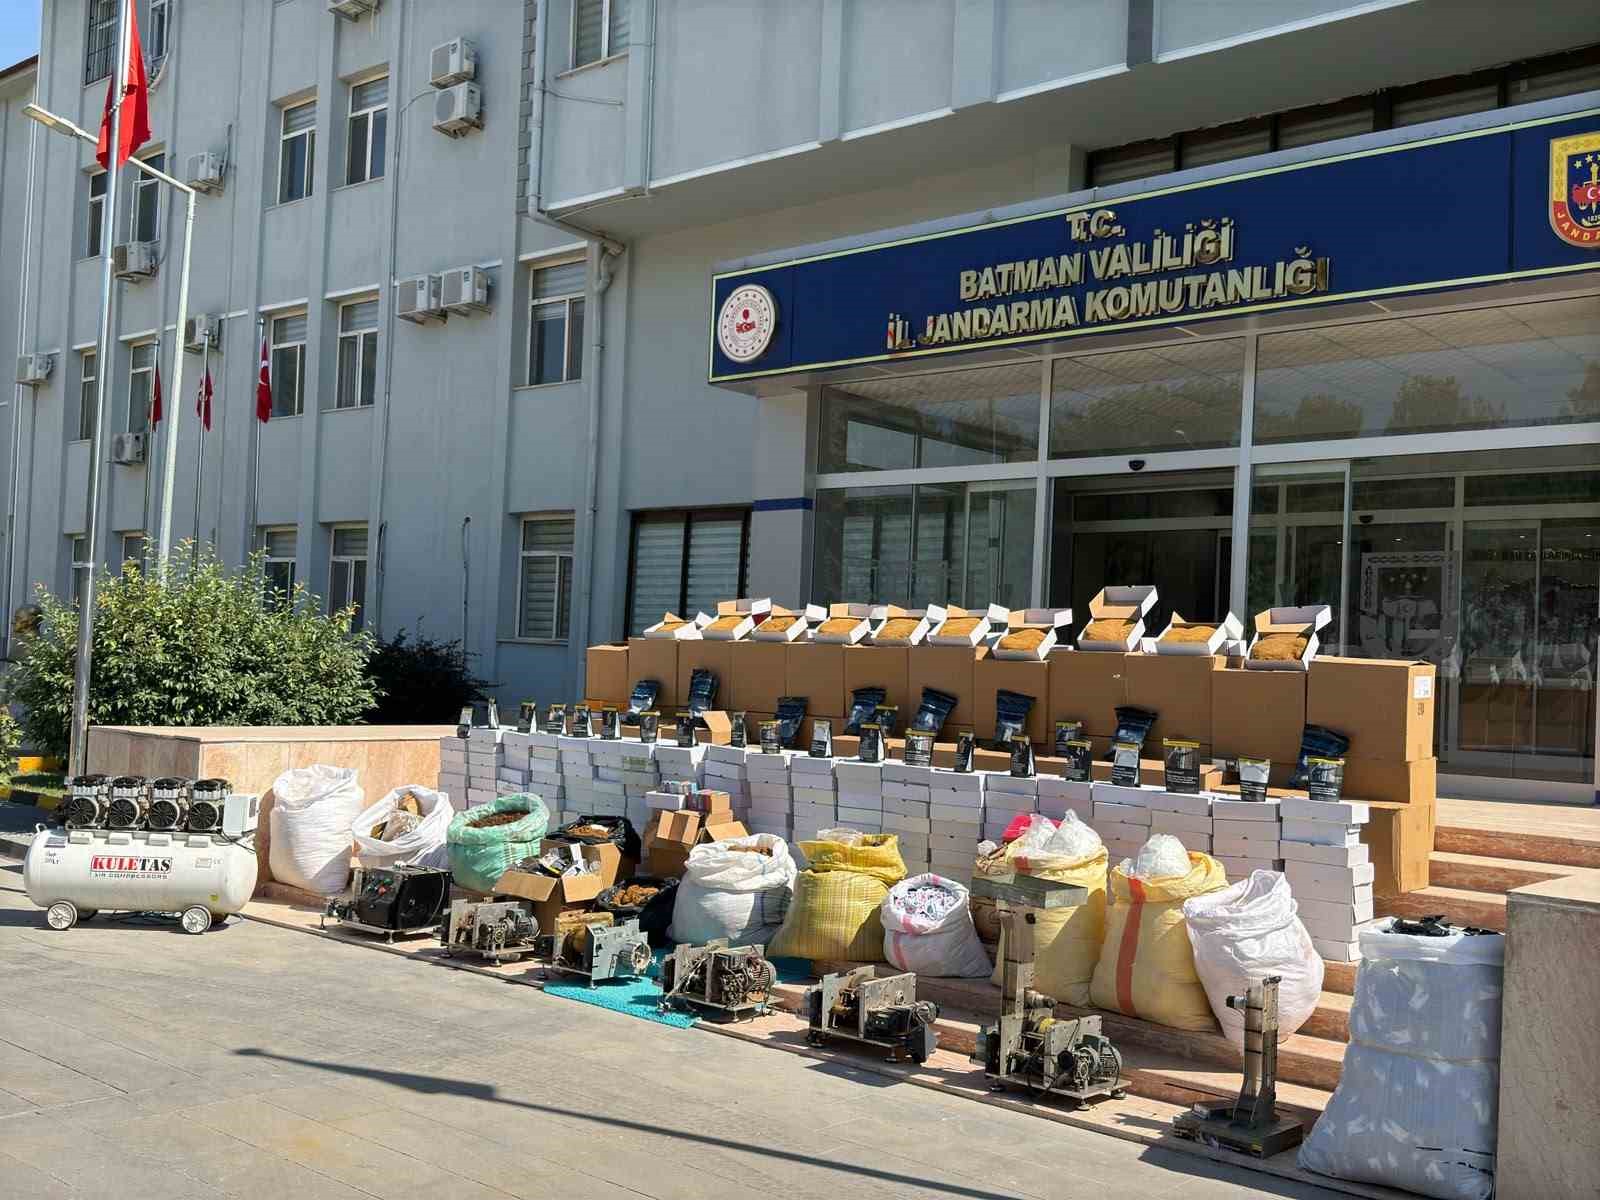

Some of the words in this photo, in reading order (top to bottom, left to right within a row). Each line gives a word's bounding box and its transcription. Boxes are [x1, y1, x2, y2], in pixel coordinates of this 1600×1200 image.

[1066, 209, 1125, 241] T.C.
[960, 252, 1085, 301] BATMAN
[1089, 217, 1234, 279] VALİLİĞİ
[918, 295, 1080, 345] JANDARMA
[1085, 246, 1329, 322] KOMUTANLIĞI
[92, 857, 171, 872] KULETAS
